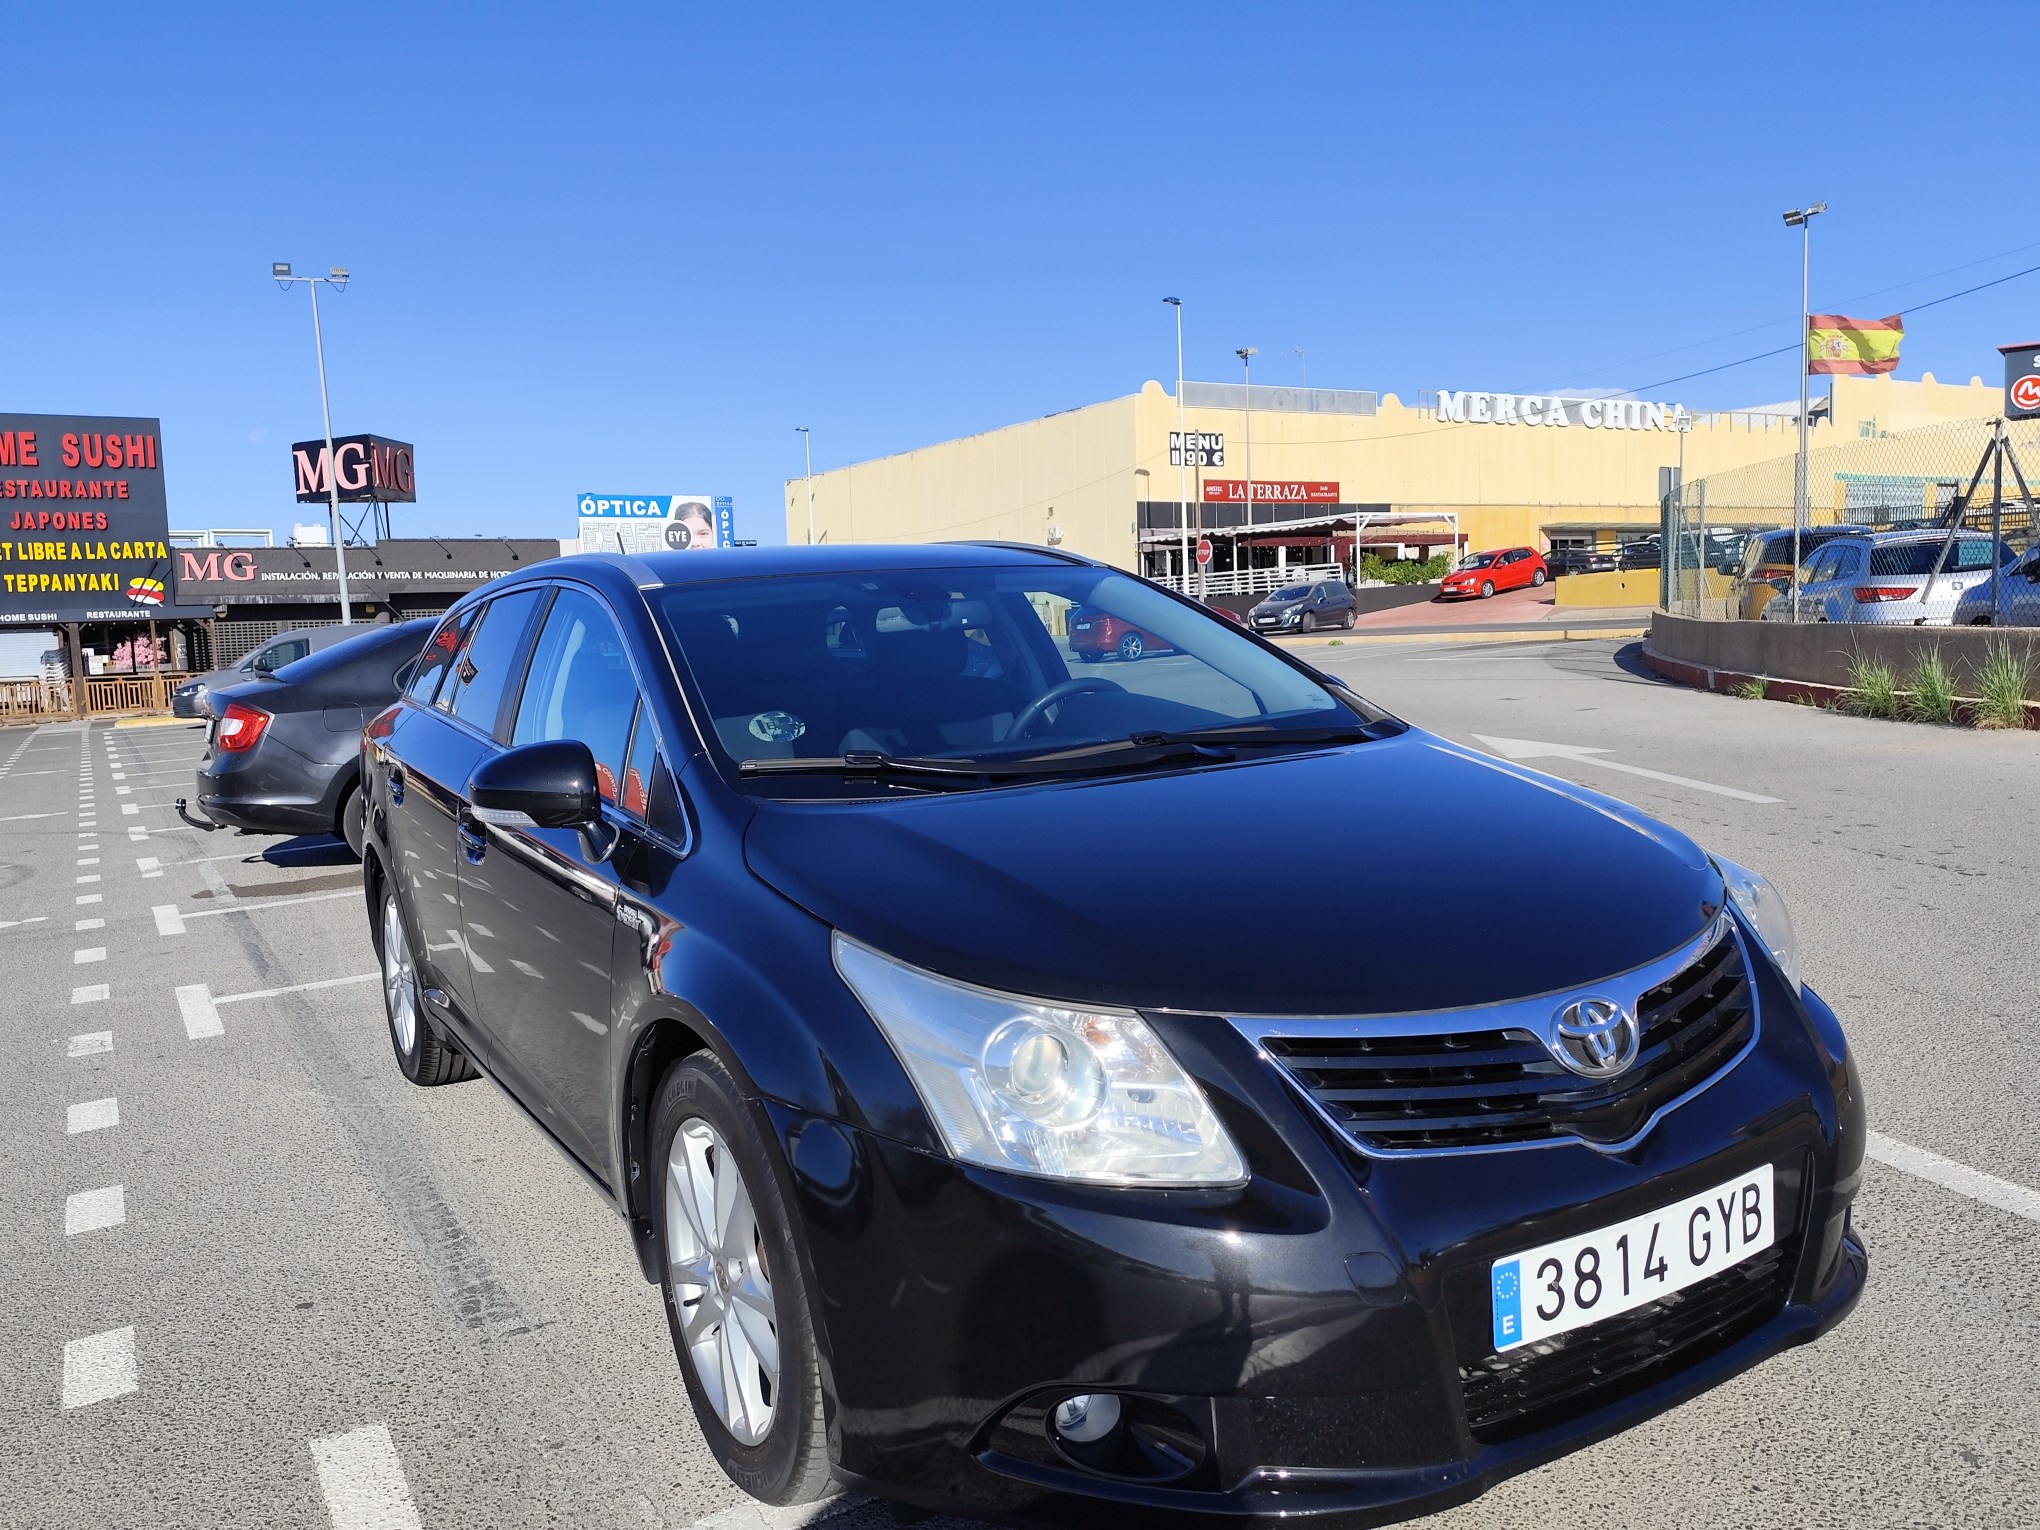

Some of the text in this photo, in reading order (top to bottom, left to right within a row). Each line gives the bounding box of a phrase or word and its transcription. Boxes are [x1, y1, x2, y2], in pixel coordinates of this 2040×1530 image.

[1437, 390, 1691, 433] MERCA CHINA
[61, 433, 157, 468] SUSHI
[1170, 432, 1223, 450] MENÚ
[371, 442, 413, 493] MG
[1212, 451, 1224, 466] €
[293, 442, 370, 495] MG
[1228, 483, 1307, 500] LA TERRAZA
[580, 496, 661, 515] ÓPTICA
[10, 512, 108, 530] JAPONES
[668, 531, 687, 542] EYE
[0, 541, 168, 561] T LIBRE A LA CARTA
[180, 552, 257, 582] MG
[261, 571, 321, 581] INSTALACIÓN,
[322, 570, 375, 580] REPACIÓN
[377, 571, 382, 579] Y
[384, 571, 410, 580] VENTA
[412, 571, 423, 579] DE
[424, 570, 478, 580] MAQUINARIA
[478, 570, 489, 579] DE
[4, 573, 119, 592] TEPPANYAKI
[28, 613, 57, 621] SUSHI
[87, 610, 151, 619] RESTAURANTE
[1536, 1183, 1762, 1322] 3814 GYB
[1503, 1314, 1515, 1335] E
